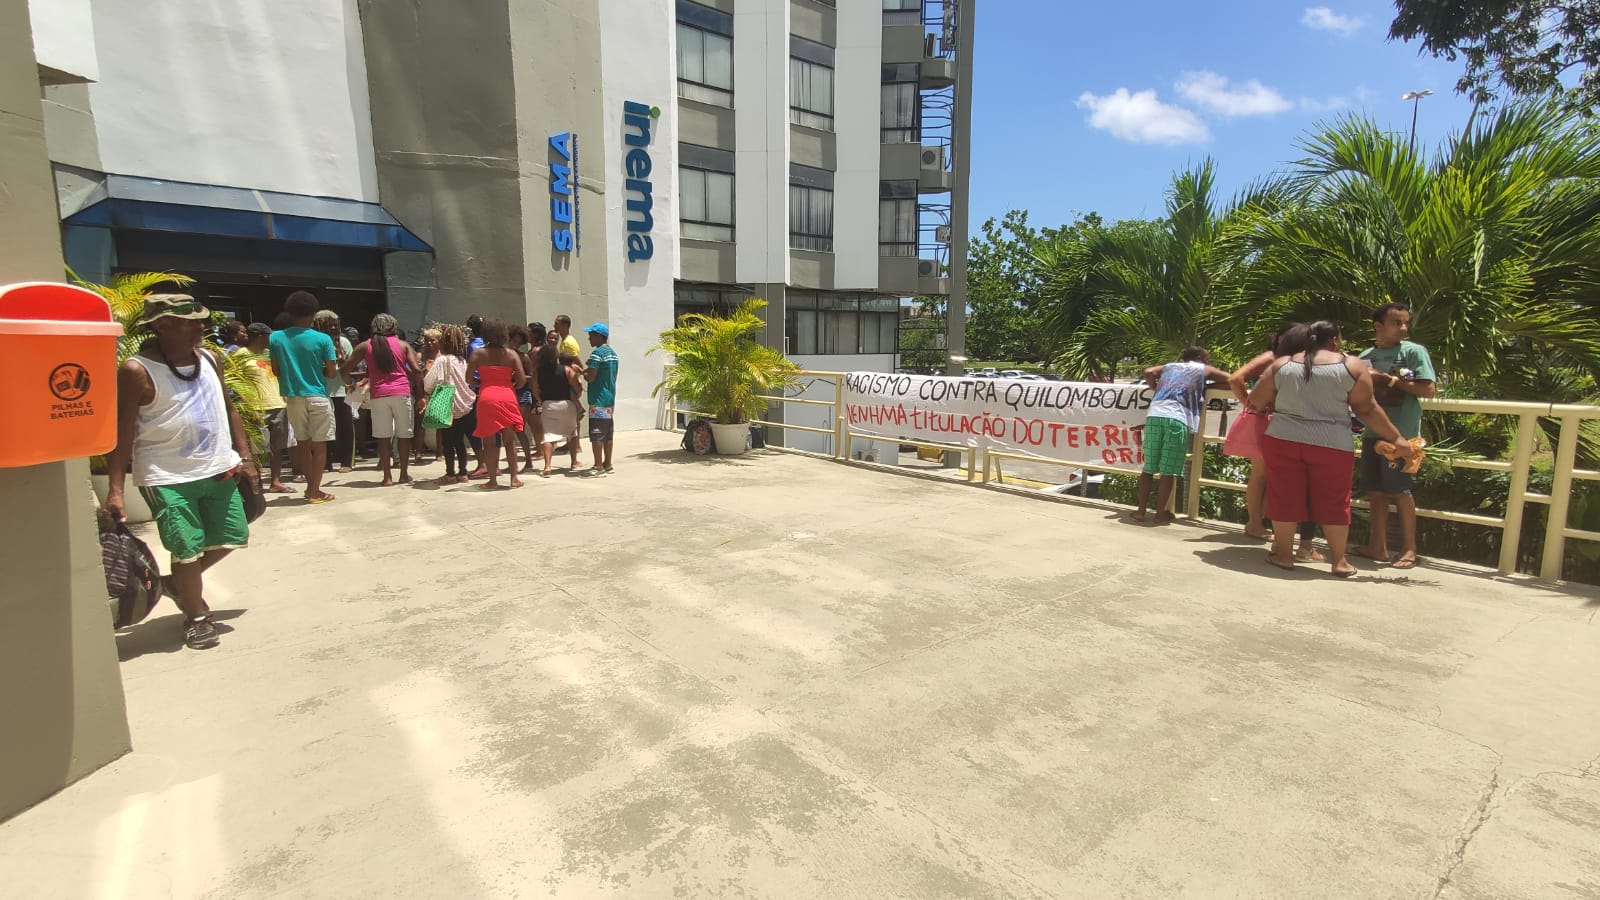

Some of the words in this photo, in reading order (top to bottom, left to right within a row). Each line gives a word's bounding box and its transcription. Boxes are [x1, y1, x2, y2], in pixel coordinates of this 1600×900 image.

[549, 132, 574, 252] SEMA
[624, 101, 661, 263] inema
[51, 402, 84, 411] PILHAS
[846, 372, 912, 396] RACISMO
[919, 379, 998, 403] CONTRA
[1005, 383, 1152, 411] QUILOMBOLAS
[50, 409, 94, 419] BATERIAS
[1013, 416, 1044, 446] DO
